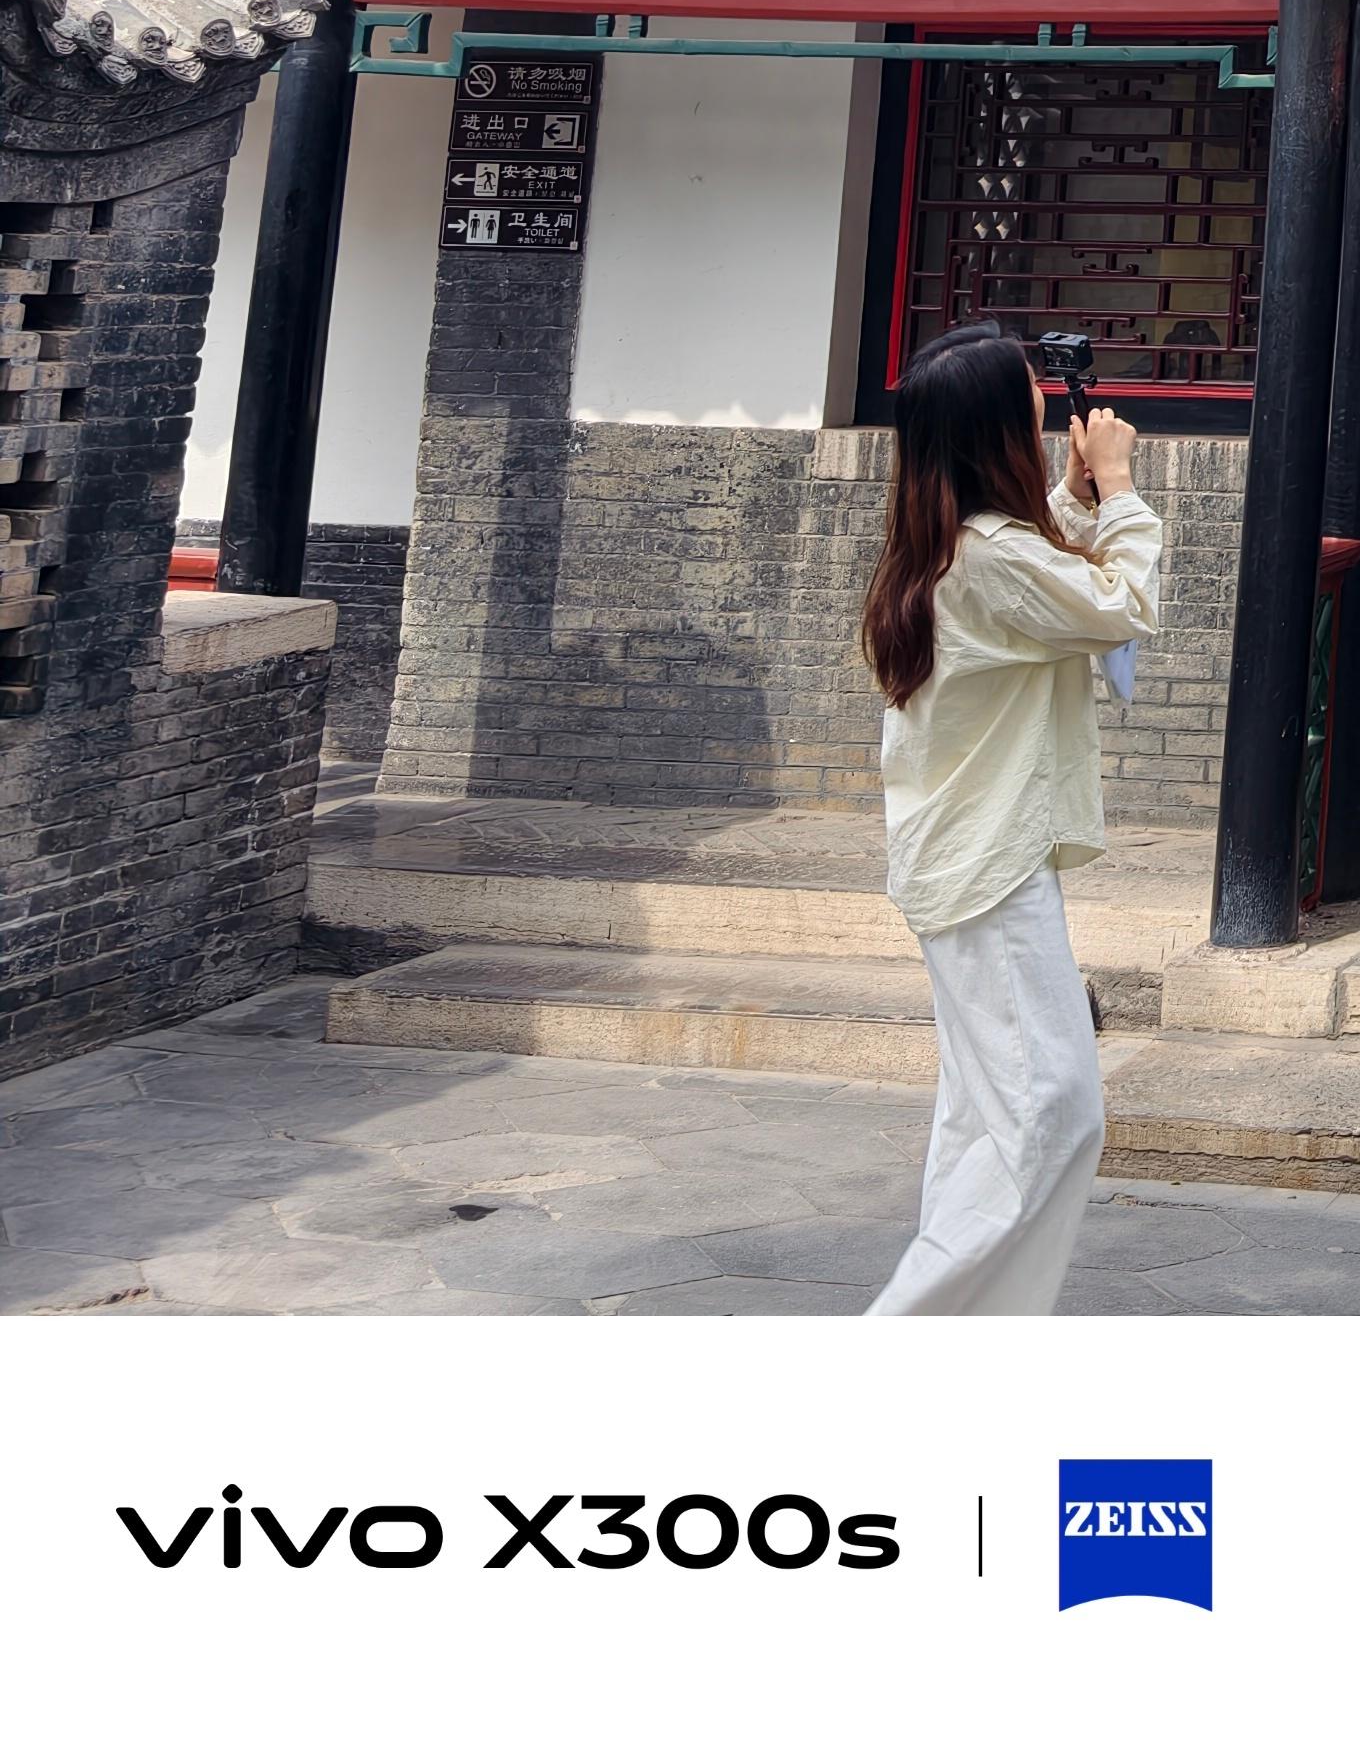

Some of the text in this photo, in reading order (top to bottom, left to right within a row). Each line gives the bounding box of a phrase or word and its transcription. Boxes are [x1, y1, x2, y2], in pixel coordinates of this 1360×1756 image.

[507, 66, 587, 81] 请勿吸烟
[511, 80, 582, 93] No Smoking
[460, 113, 529, 131] 进出口
[466, 131, 523, 141] GATEWAY
[500, 164, 579, 180] 安全通道
[528, 181, 556, 189] EXIT
[507, 211, 573, 229] 卫生间
[524, 228, 561, 237] TOILET
